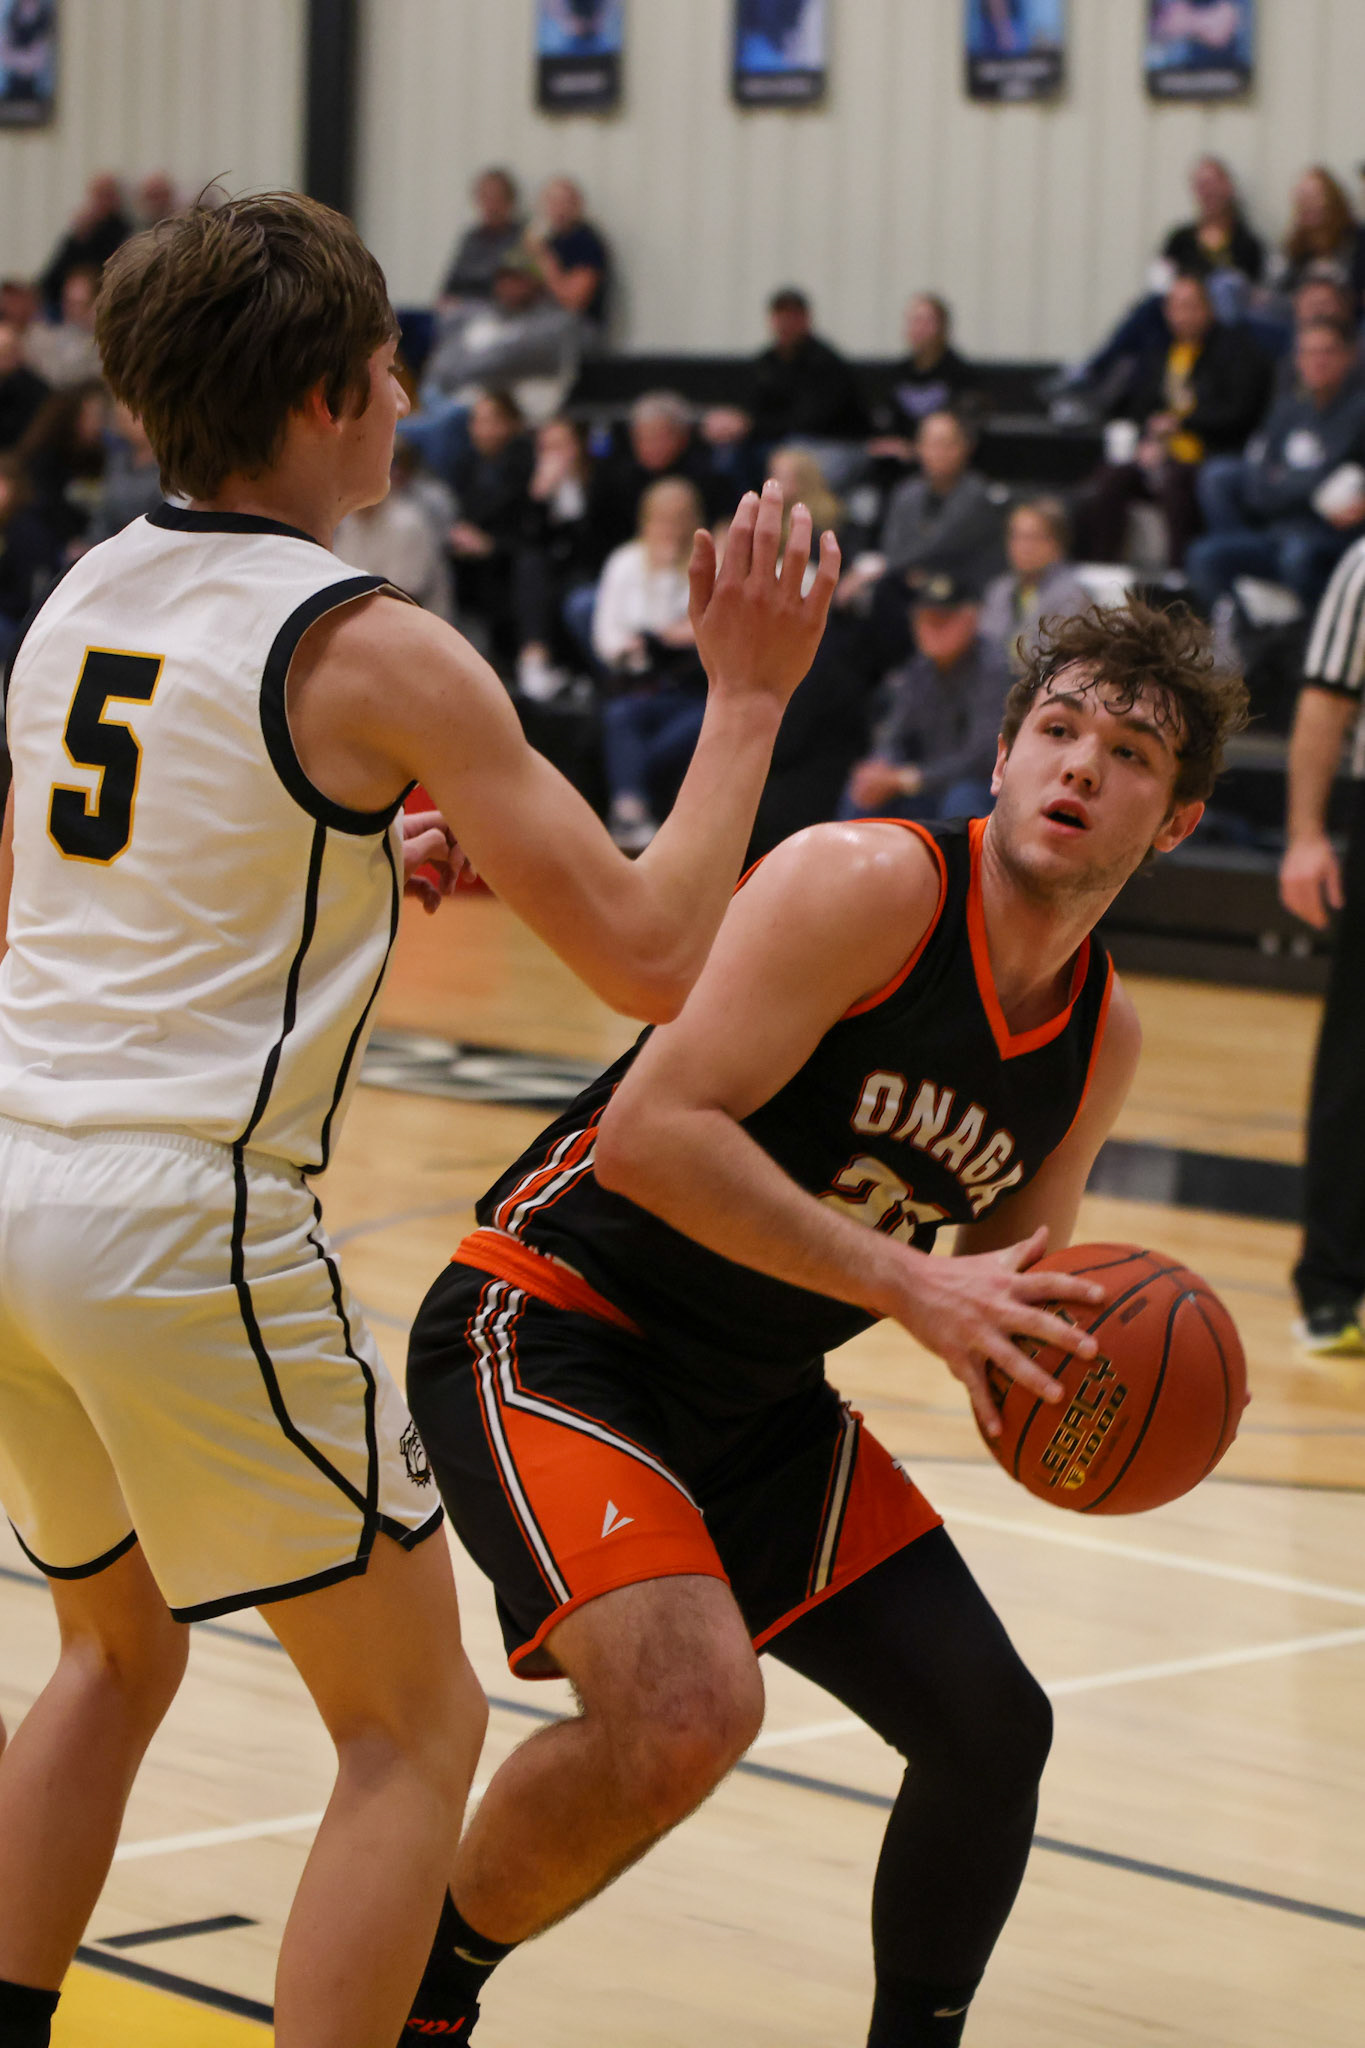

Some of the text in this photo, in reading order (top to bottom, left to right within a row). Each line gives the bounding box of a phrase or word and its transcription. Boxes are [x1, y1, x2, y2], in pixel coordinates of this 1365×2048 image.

[46, 645, 166, 867] 5
[850, 1069, 1024, 1219] ONAGA
[1036, 1352, 1117, 1488] LEGACY
